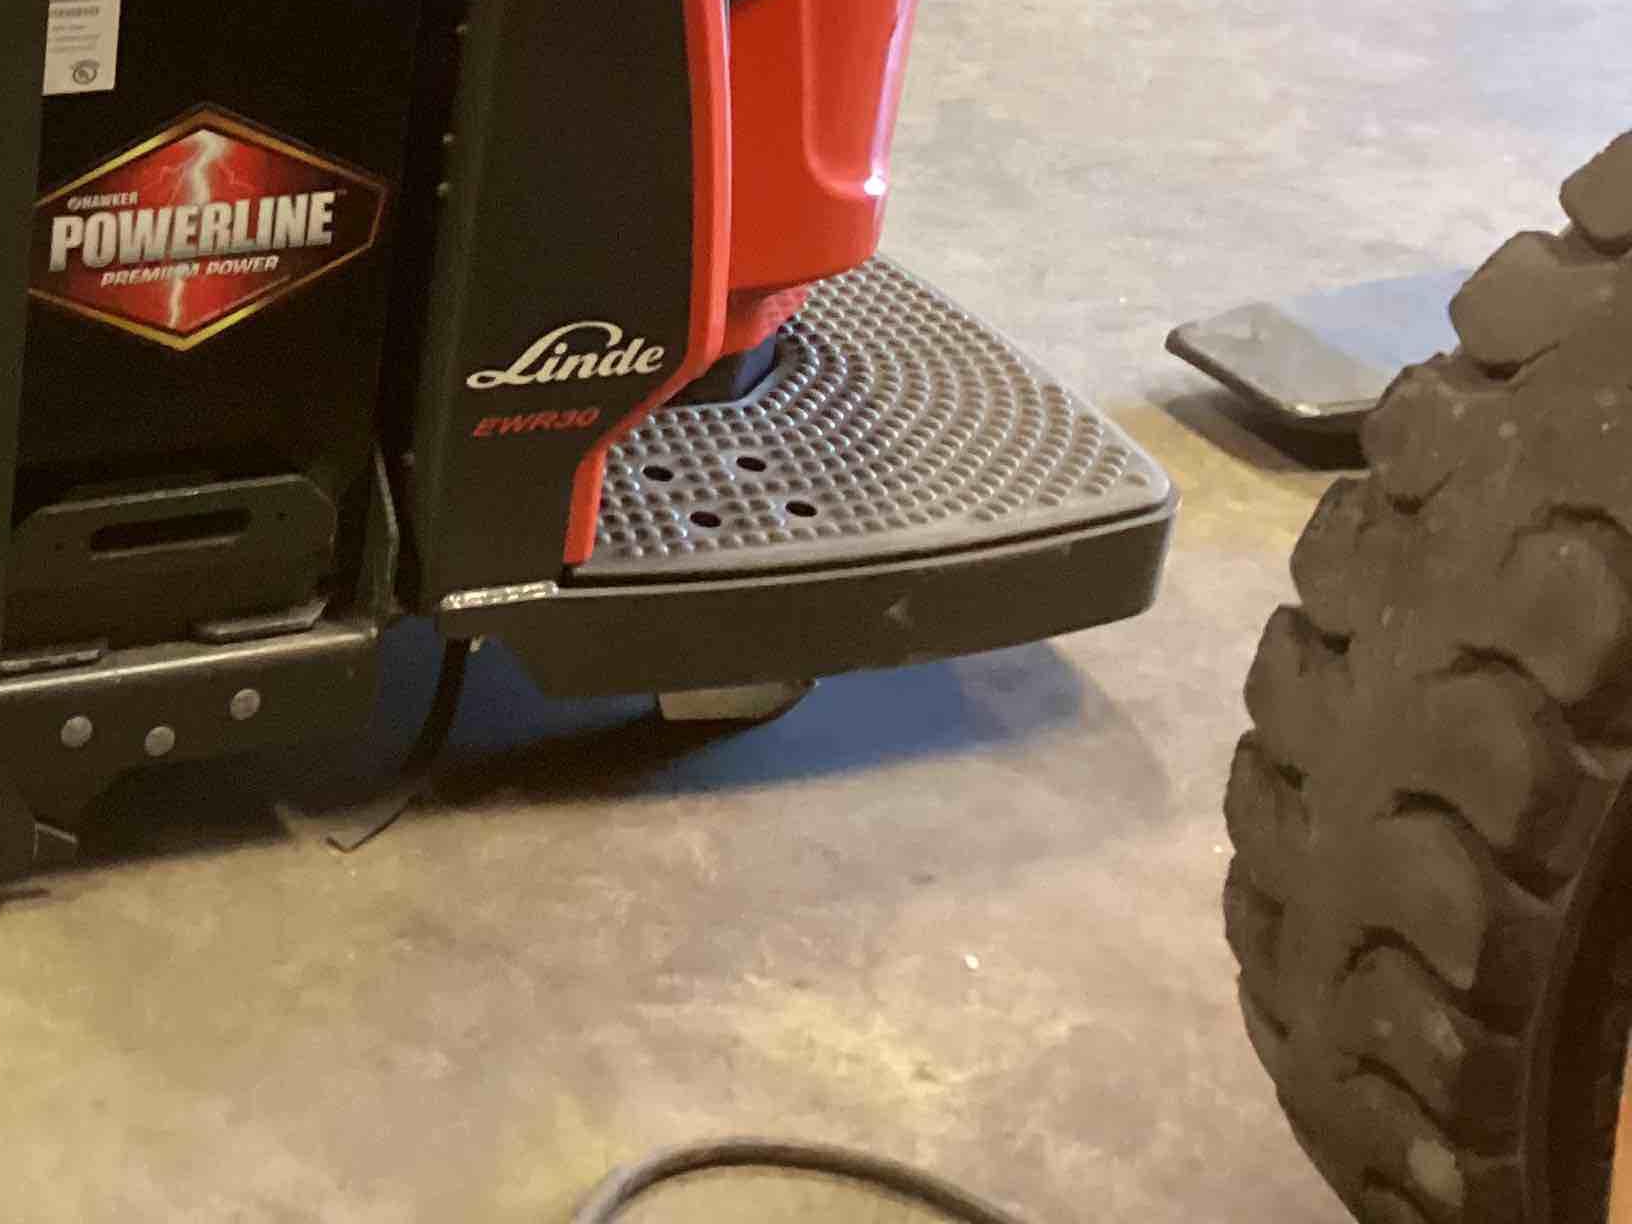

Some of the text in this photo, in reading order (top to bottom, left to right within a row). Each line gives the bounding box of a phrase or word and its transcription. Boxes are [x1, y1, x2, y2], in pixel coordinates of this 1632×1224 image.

[81, 191, 139, 209] HAWKER
[48, 190, 337, 272] POWERLINE
[205, 254, 280, 276] POWER
[465, 319, 666, 390] Linde
[472, 406, 602, 438] EWR30
